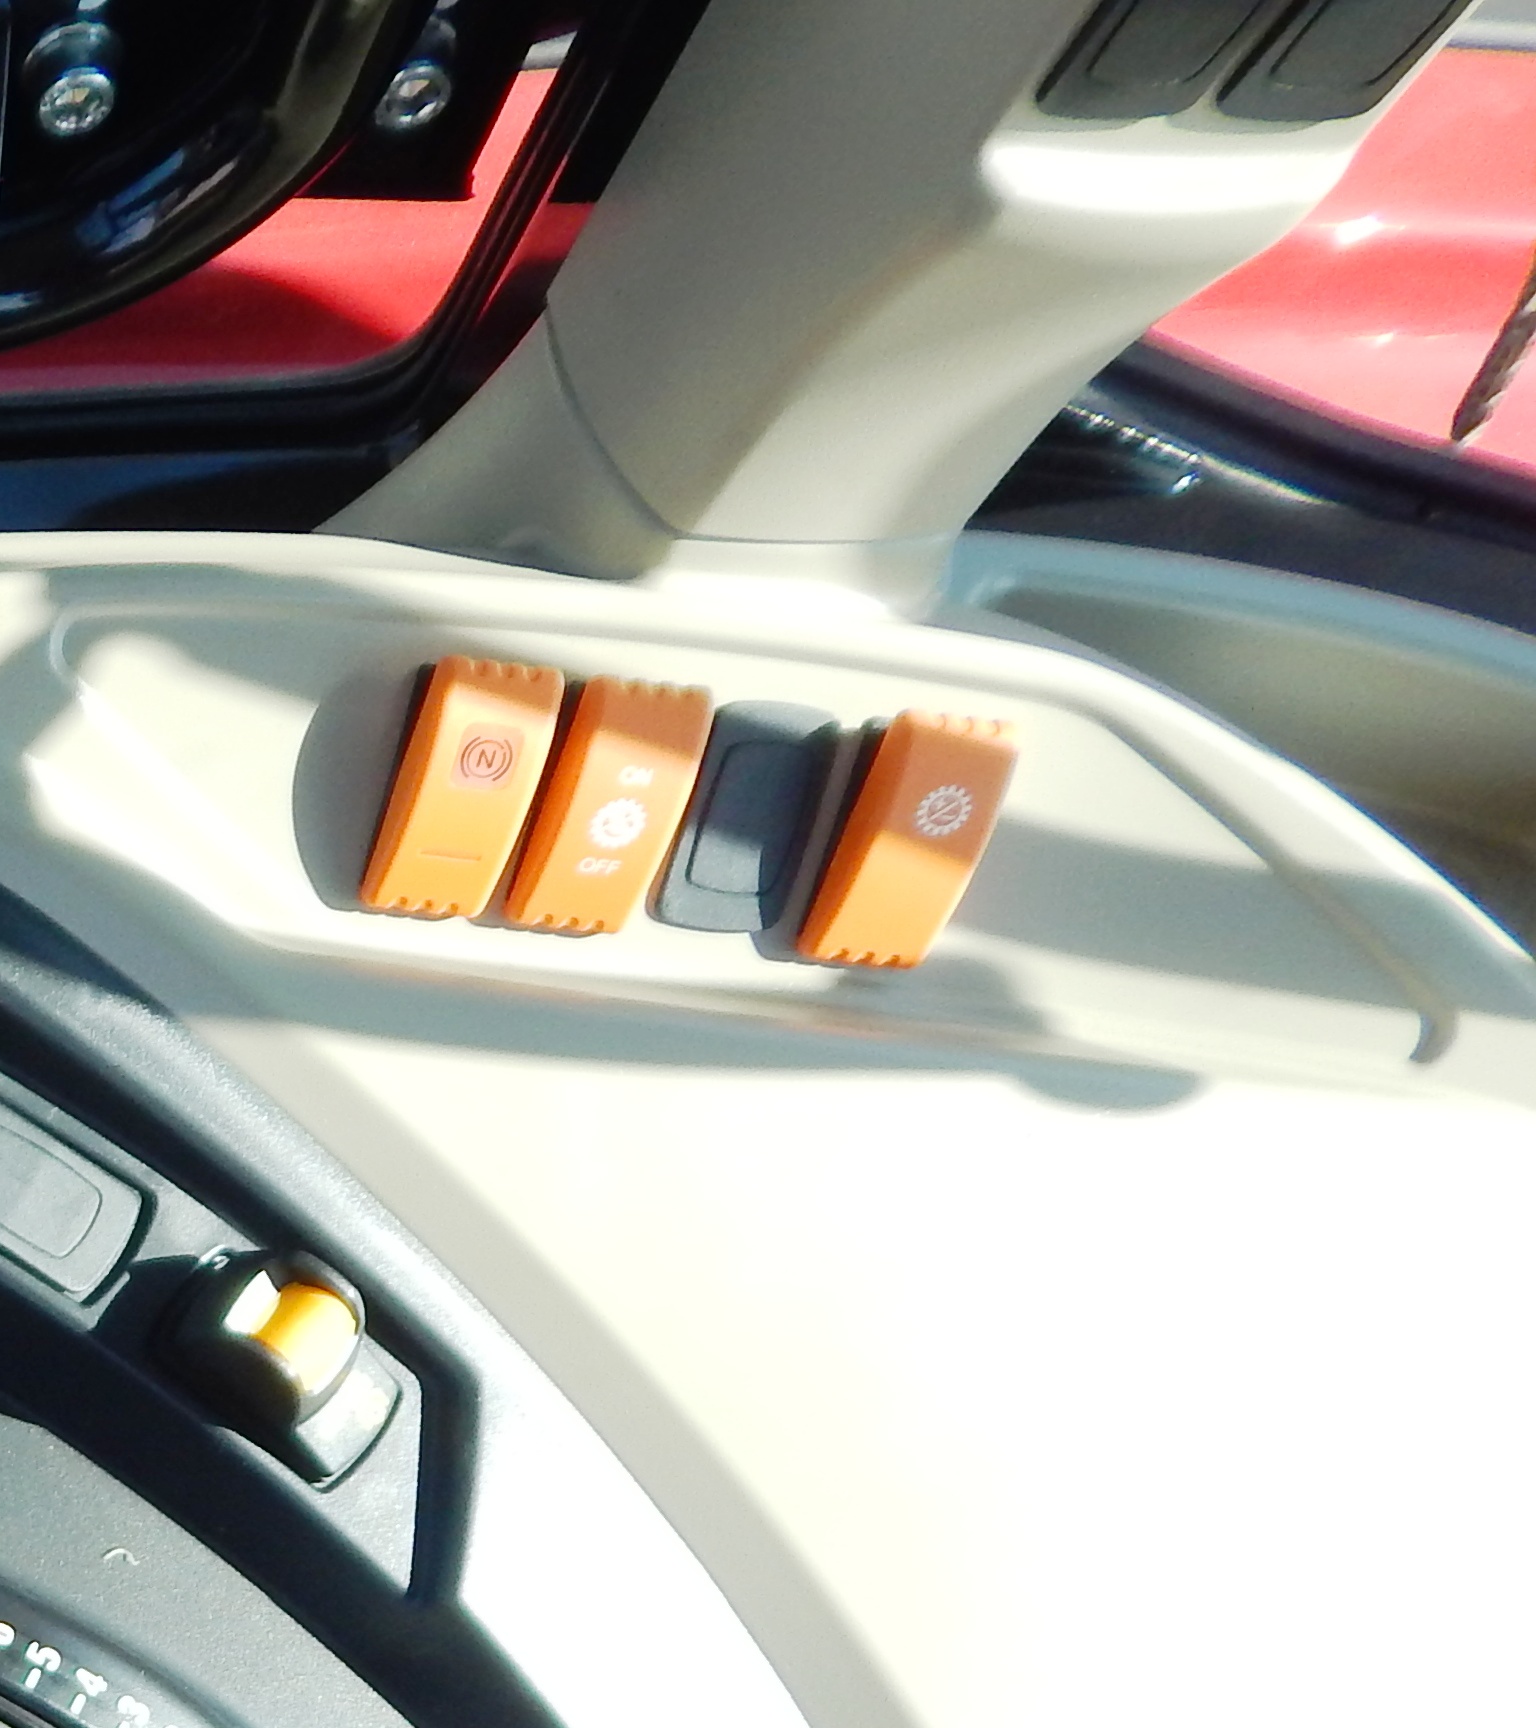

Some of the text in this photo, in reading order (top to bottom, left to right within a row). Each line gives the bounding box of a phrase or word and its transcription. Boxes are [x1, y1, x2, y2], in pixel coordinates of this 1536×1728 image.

[475, 747, 497, 769] N
[620, 765, 654, 786] ON
[579, 857, 621, 874] OFF
[25, 1641, 62, 1672] 5
[75, 1667, 108, 1698] 4
[116, 1694, 151, 1726] 3
